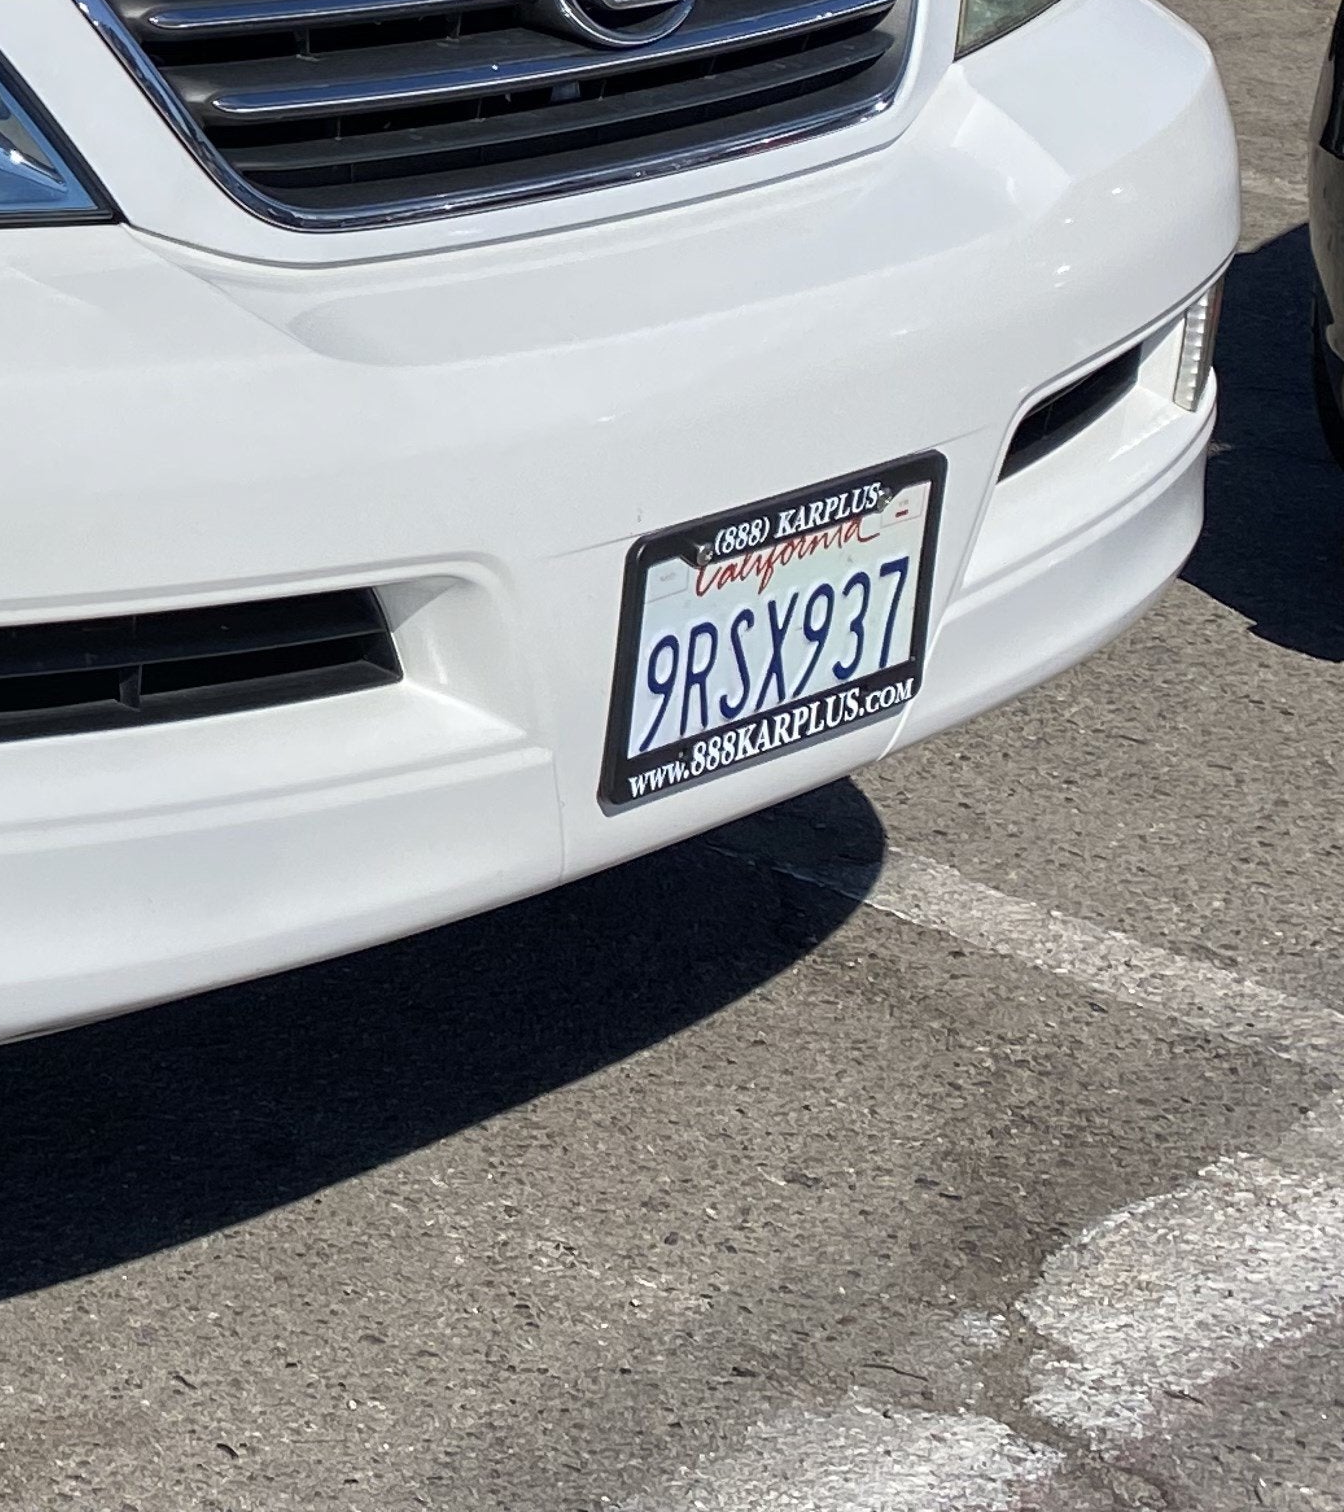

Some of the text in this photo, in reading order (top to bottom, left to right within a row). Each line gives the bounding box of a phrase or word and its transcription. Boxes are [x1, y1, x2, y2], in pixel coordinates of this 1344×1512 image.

[714, 482, 882, 555] (888) KARPLUS
[639, 555, 910, 752] 9RSX937
